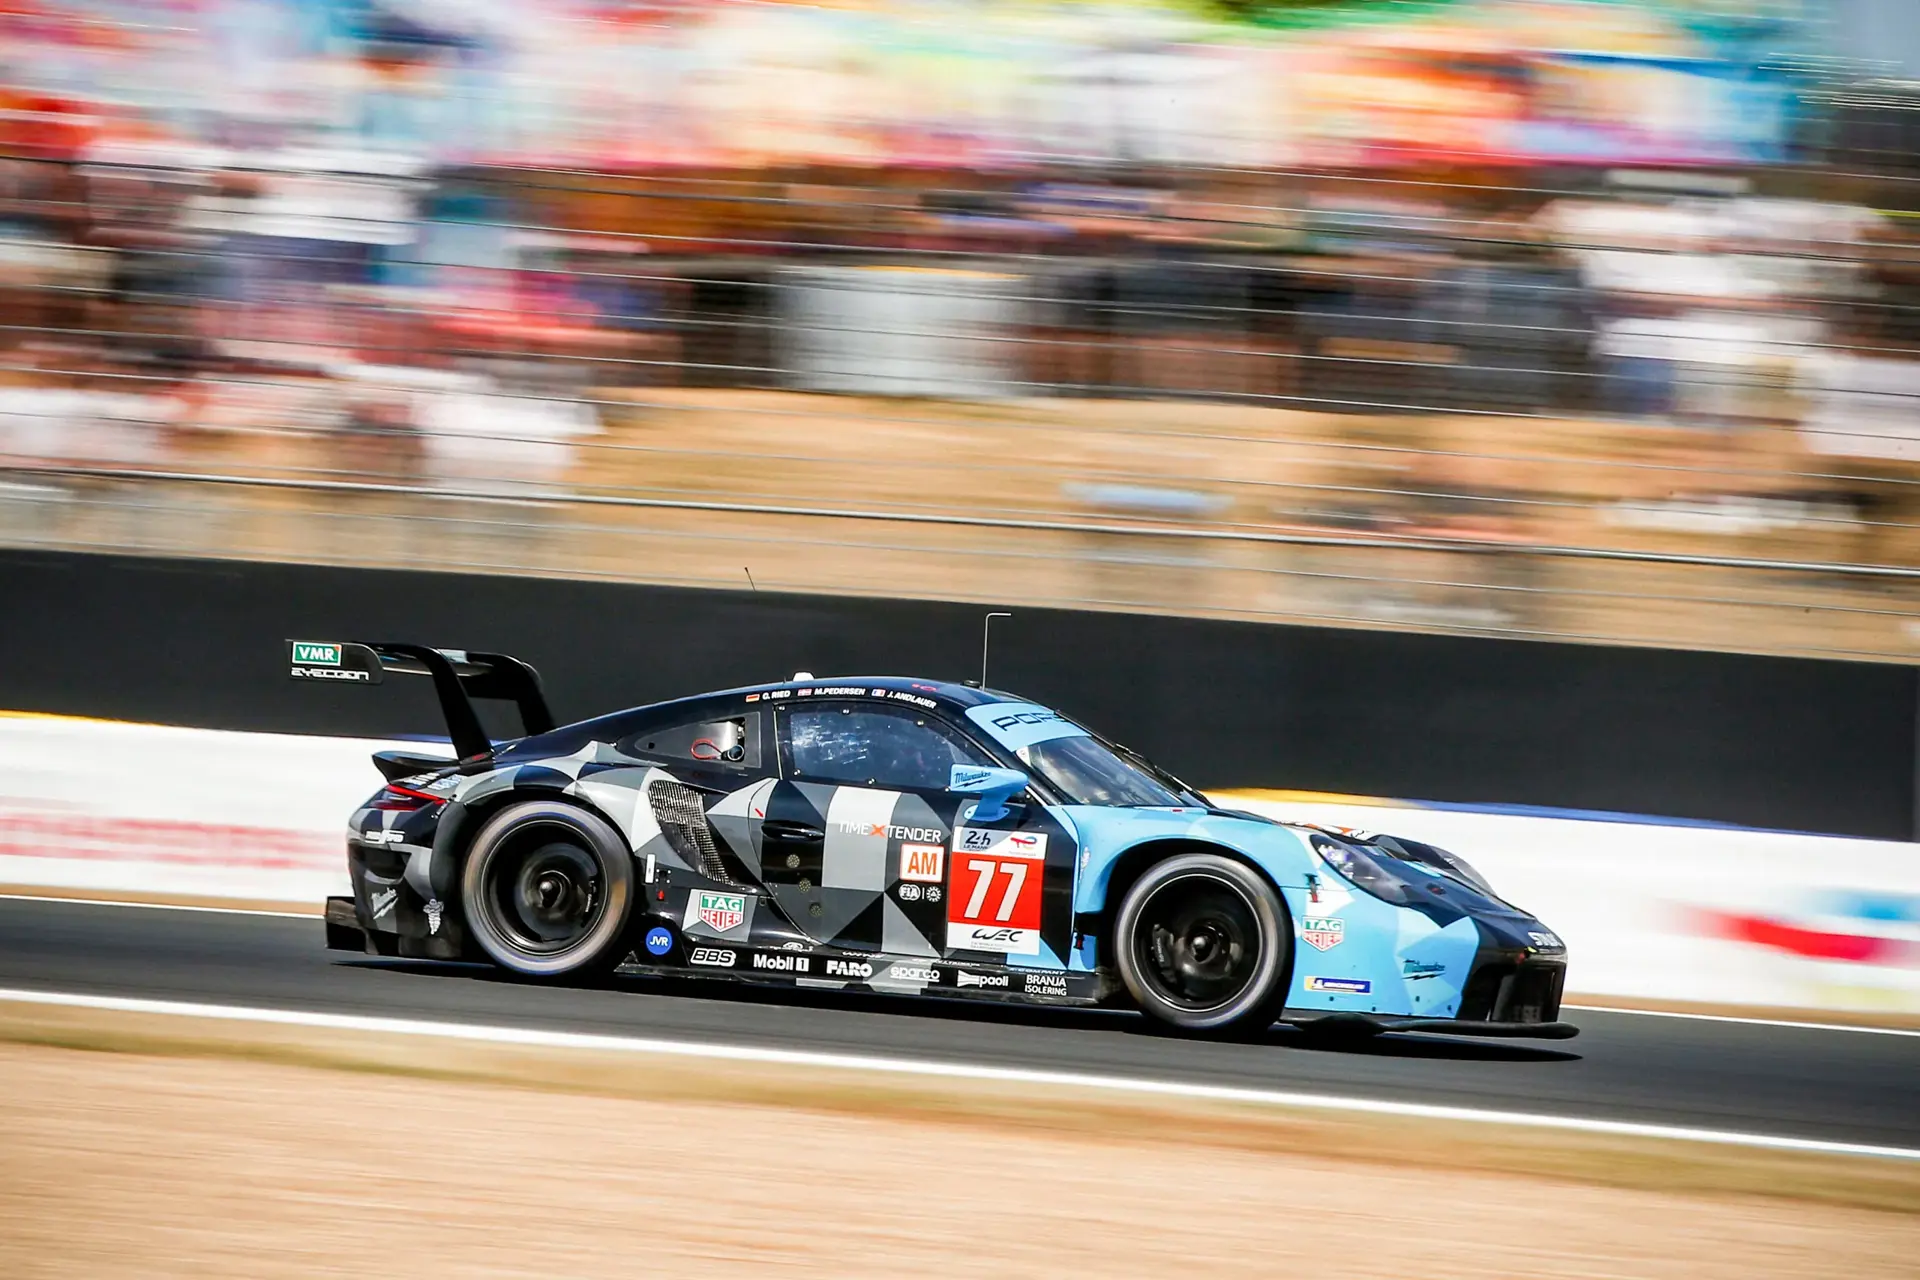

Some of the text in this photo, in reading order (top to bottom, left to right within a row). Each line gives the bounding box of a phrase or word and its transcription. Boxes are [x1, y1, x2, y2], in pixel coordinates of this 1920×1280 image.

[298, 646, 336, 661] VMR
[954, 771, 992, 784] Milwaukee
[907, 851, 938, 876] AM
[900, 885, 919, 899] FIA
[964, 859, 1028, 922] 77
[704, 896, 740, 911] TAG
[702, 910, 741, 929] HEUER
[1306, 919, 1342, 931] TAG
[649, 935, 669, 946] JVR
[972, 928, 1023, 942] WEC
[692, 948, 734, 965] BBS
[753, 954, 793, 970] Mobil
[826, 960, 873, 977] FARO
[890, 966, 941, 982] sparco
[979, 975, 1009, 988] paoli
[1026, 974, 1067, 987] BRANJA
[1024, 985, 1067, 996] ISOLERING
